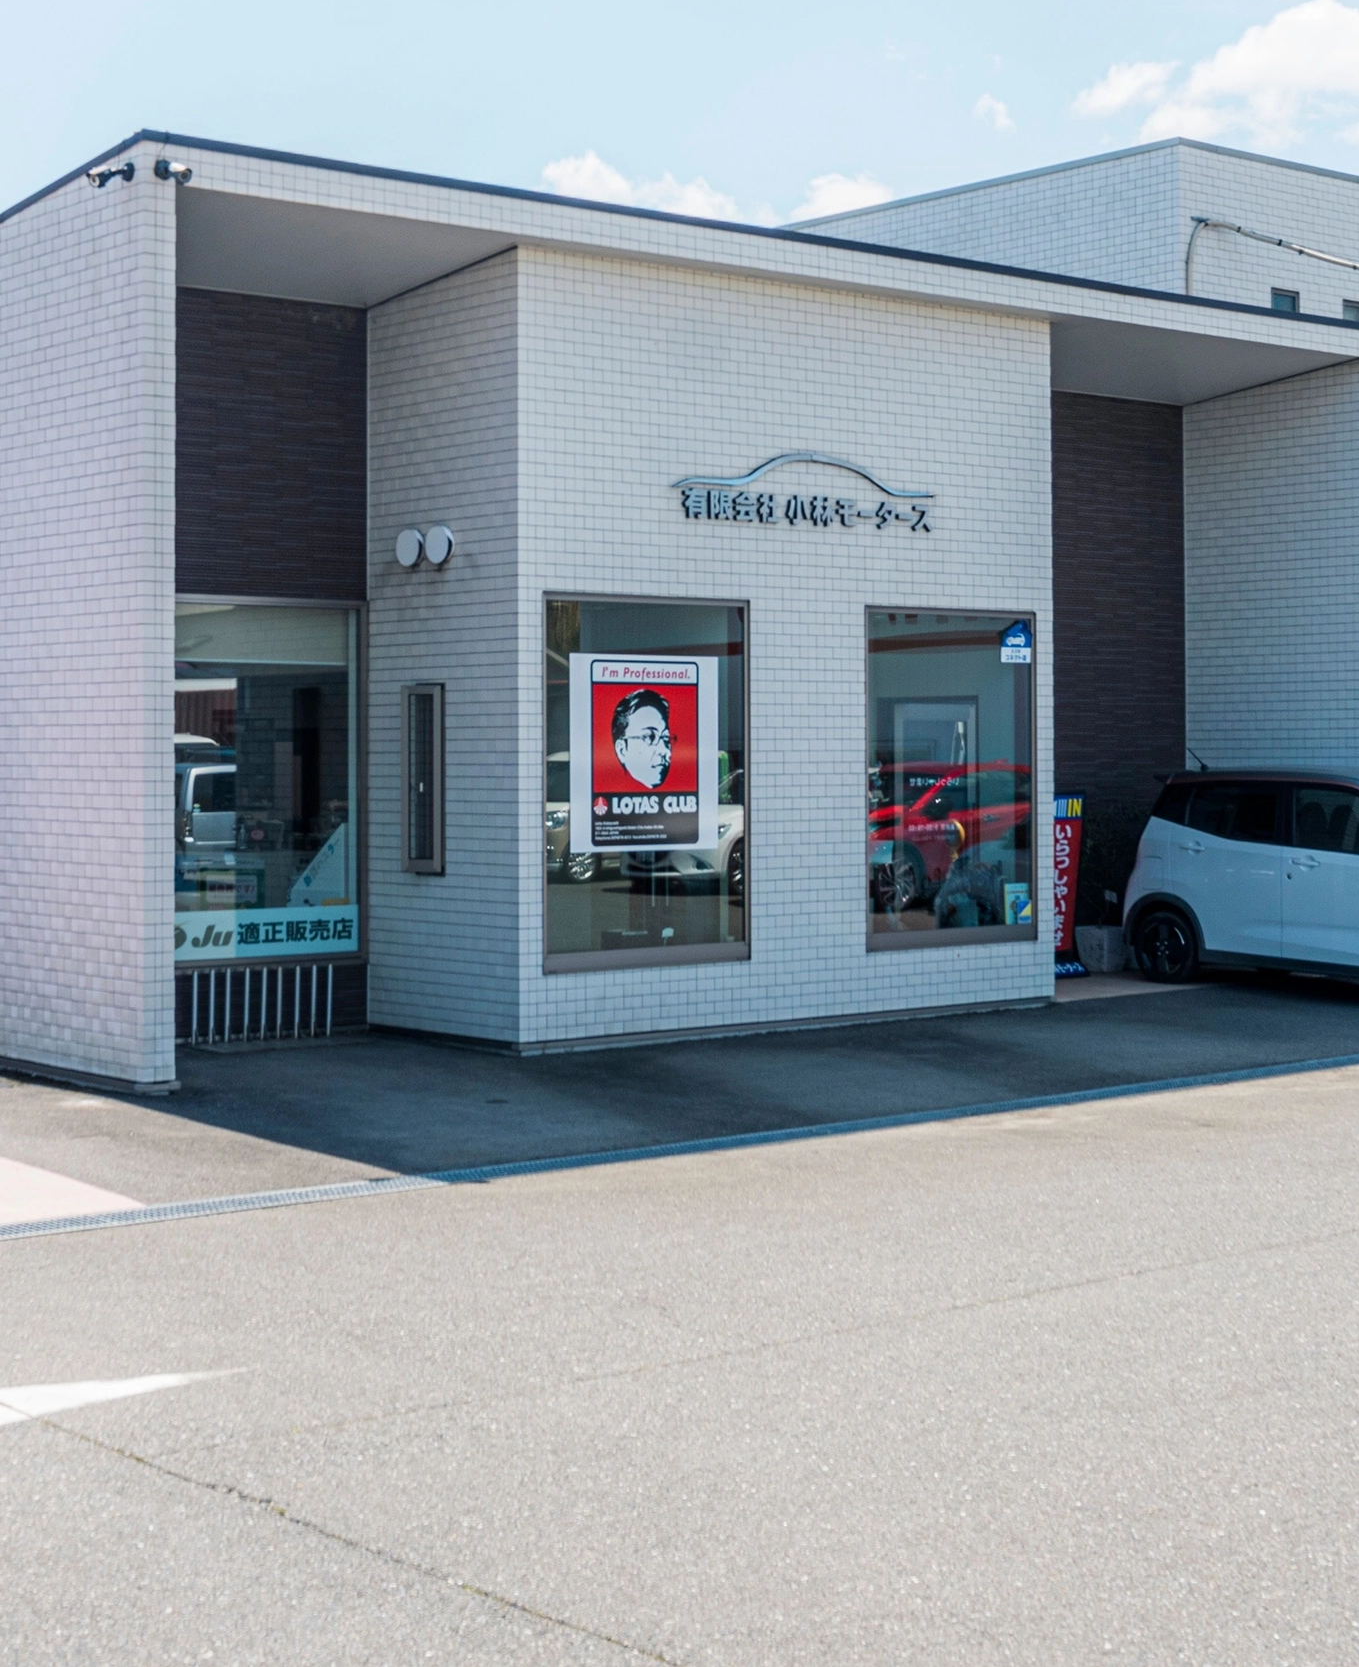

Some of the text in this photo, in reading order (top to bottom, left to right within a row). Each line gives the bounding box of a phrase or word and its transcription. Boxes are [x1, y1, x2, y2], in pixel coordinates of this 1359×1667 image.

[681, 487, 932, 533] 有限会社 小林モータース
[602, 667, 691, 681] I'm Professional.
[612, 795, 697, 815] LOTAS CLUB
[191, 918, 354, 948] Ju 適正販売店
